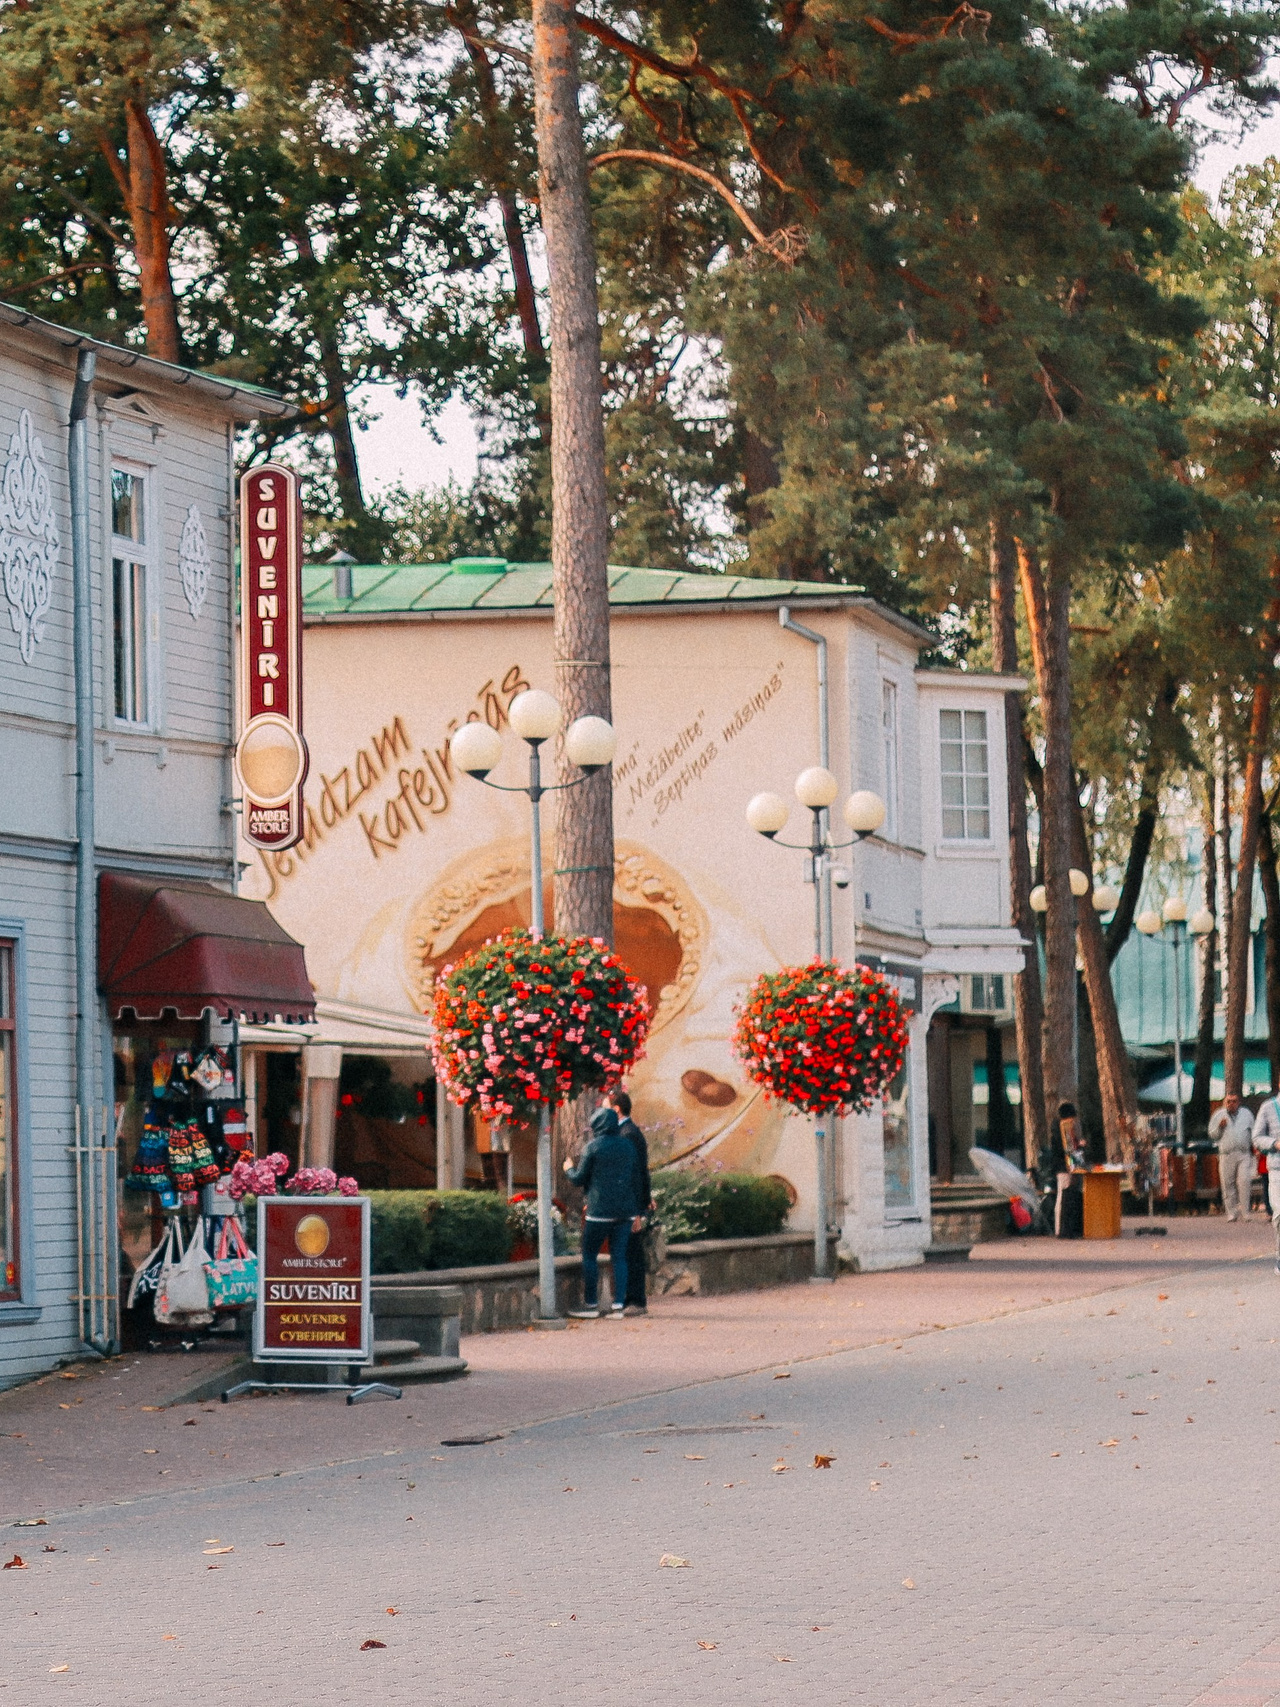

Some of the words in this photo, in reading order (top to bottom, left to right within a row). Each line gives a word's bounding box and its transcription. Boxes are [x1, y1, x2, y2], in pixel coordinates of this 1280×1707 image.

[256, 478, 280, 707] SUVENĪRI
[250, 810, 289, 822] AMBER
[251, 822, 288, 834] STORE
[270, 1282, 357, 1300] SUVENĪRI
[280, 1314, 347, 1324] SOUVENIRS
[280, 1331, 346, 1342] СУВЕНИРЫ
